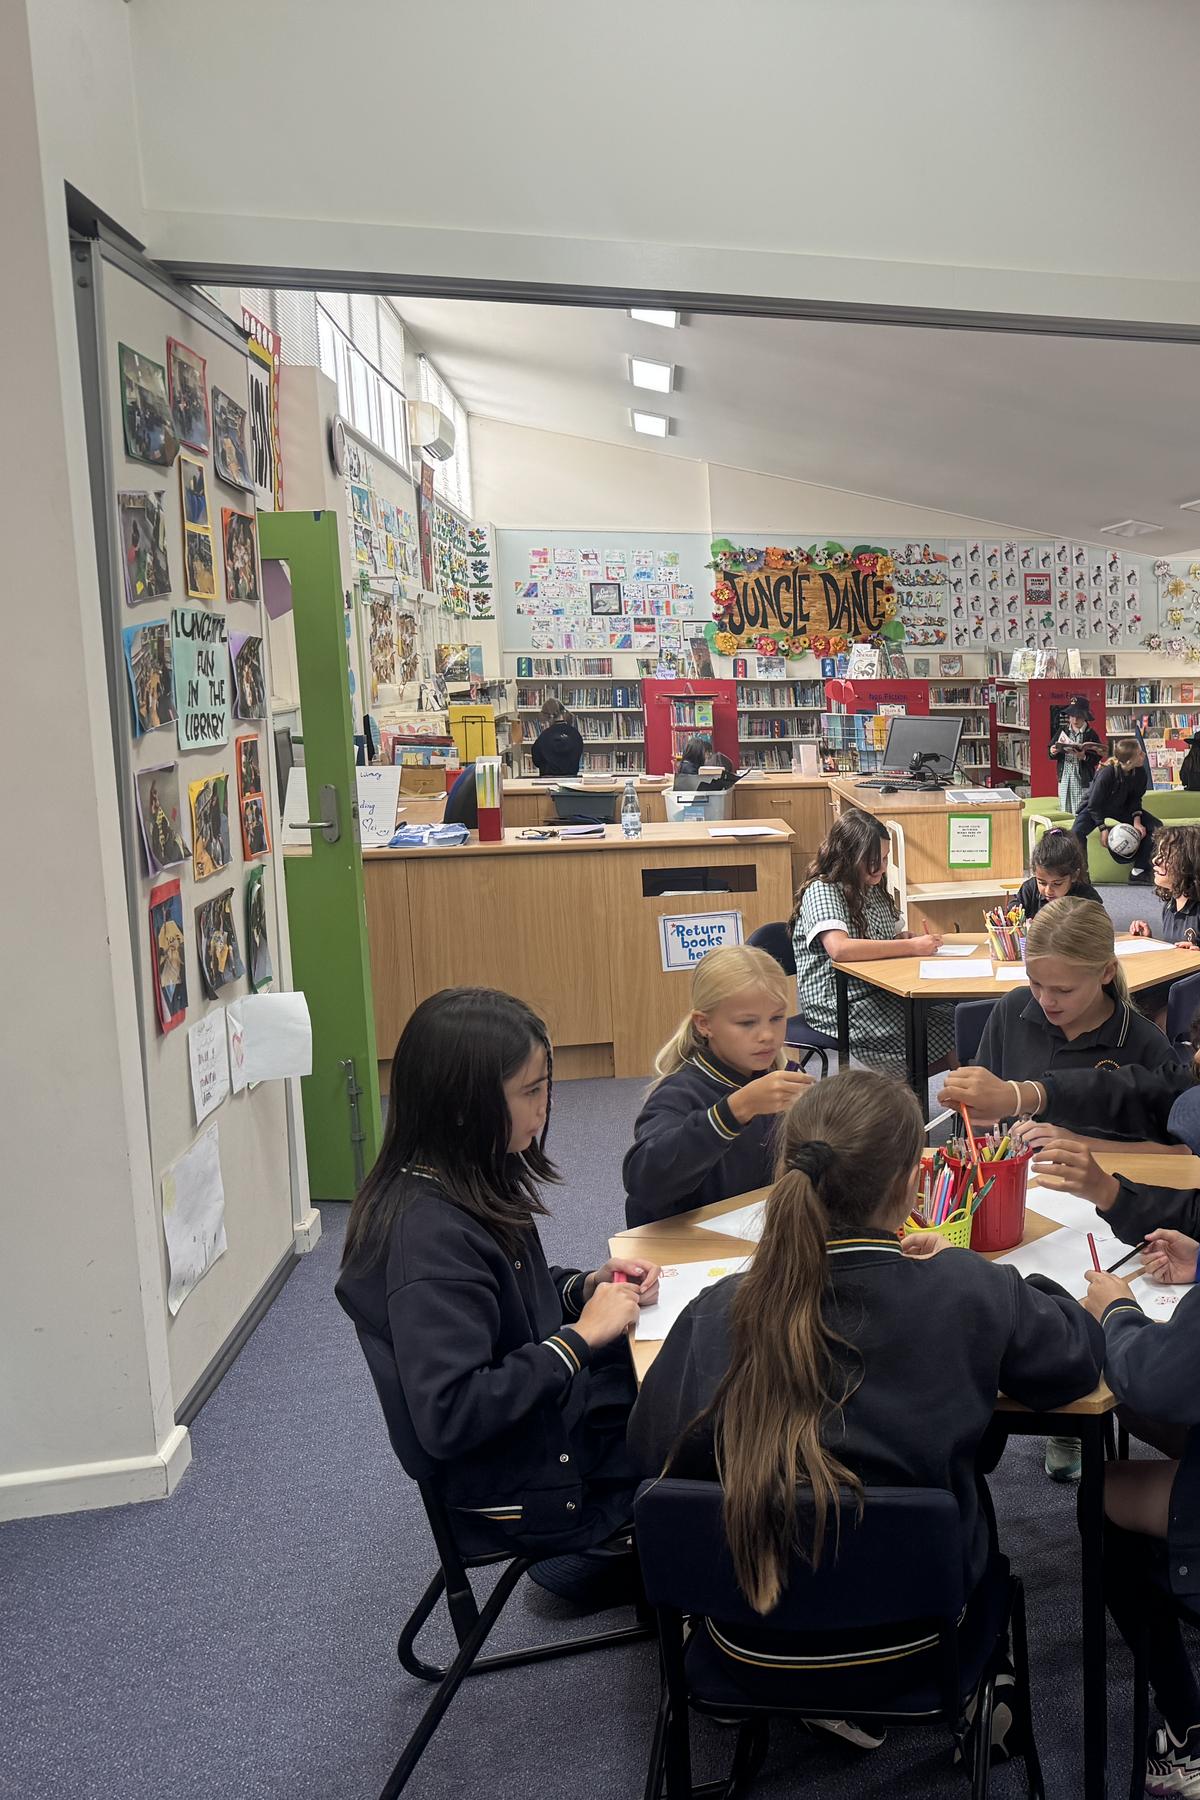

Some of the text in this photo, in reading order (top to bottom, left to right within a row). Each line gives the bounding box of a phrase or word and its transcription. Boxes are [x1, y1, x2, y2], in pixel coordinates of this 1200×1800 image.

[723, 566, 886, 638] JUNGLE DANCE
[197, 650, 215, 677] FUN
[188, 679, 226, 708] IN THE
[185, 712, 225, 741] LIBRARY
[676, 924, 726, 938] Return
[681, 935, 723, 948] books
[688, 948, 711, 961] her
